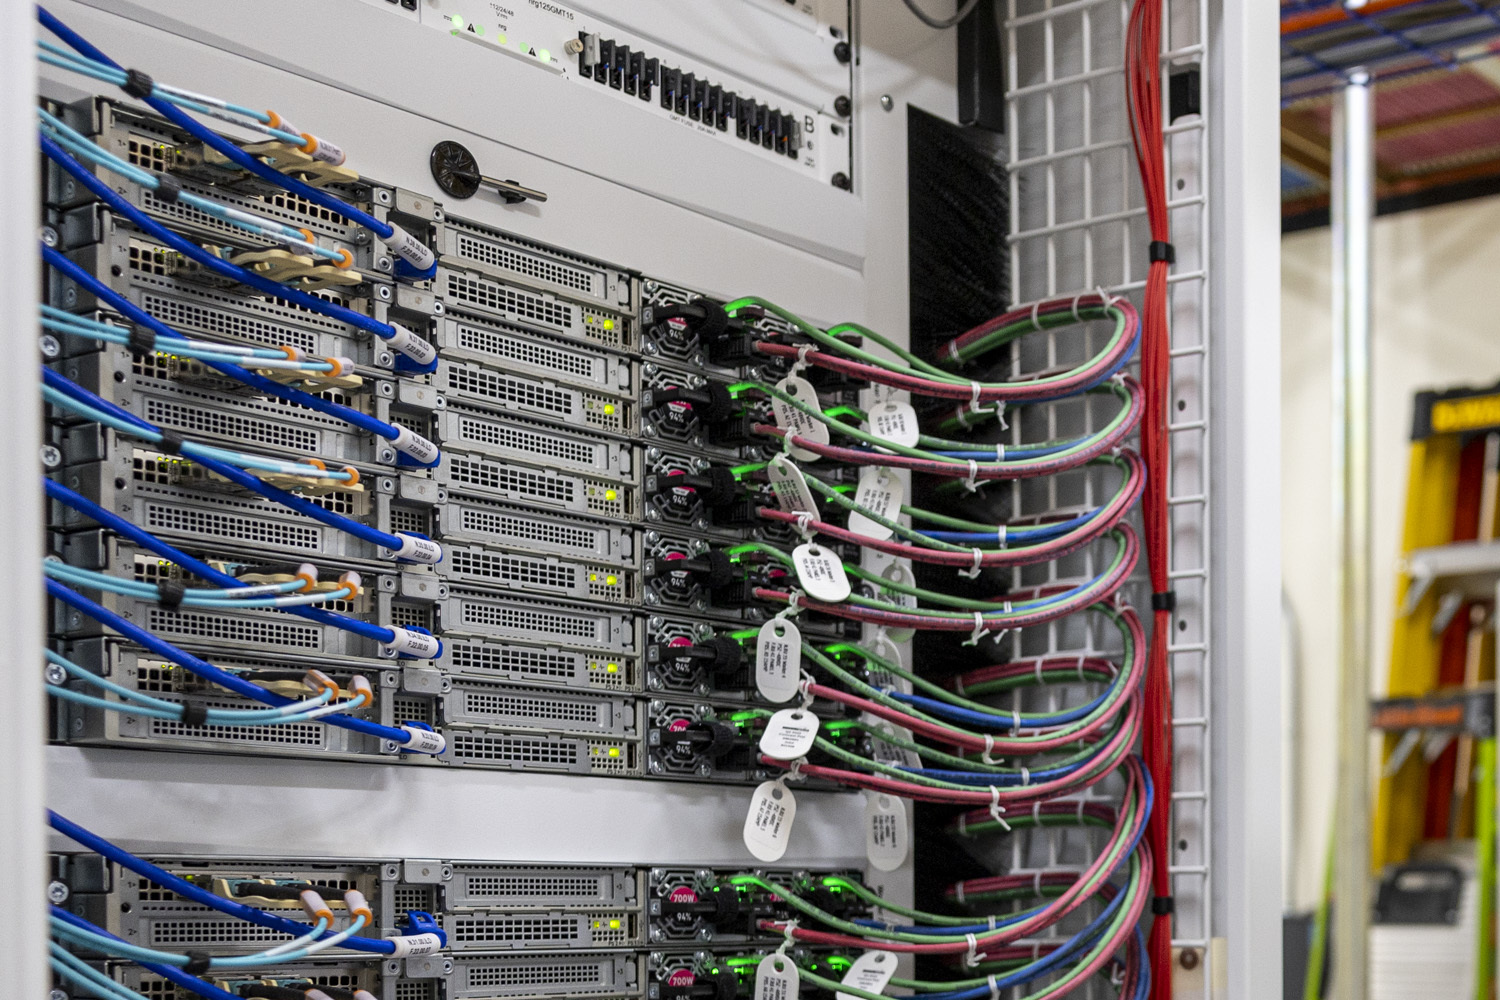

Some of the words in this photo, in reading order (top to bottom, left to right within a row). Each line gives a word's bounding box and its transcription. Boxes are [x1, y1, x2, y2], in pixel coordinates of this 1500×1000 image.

[803, 115, 815, 133] B
[668, 329, 684, 340] 94%
[668, 411, 684, 423] 94%
[672, 495, 688, 506] 94%
[670, 577, 686, 588] 94%
[675, 662, 690, 672] 94%
[675, 744, 691, 754] 94%
[673, 893, 694, 903] 700W
[676, 912, 692, 921] 94%
[672, 976, 694, 986] 700W
